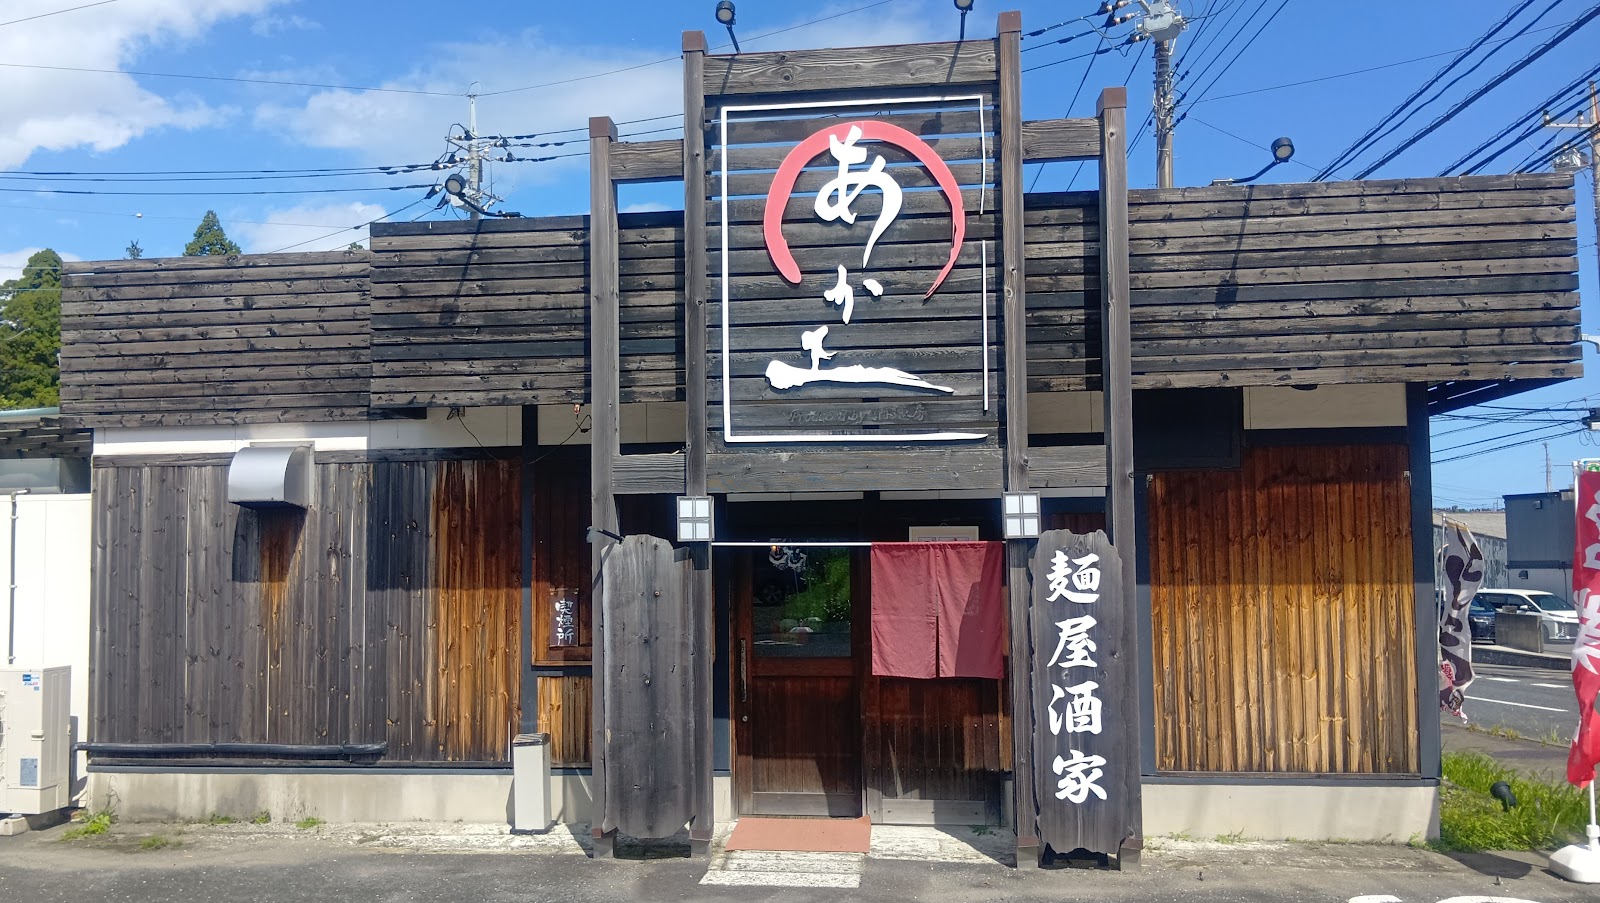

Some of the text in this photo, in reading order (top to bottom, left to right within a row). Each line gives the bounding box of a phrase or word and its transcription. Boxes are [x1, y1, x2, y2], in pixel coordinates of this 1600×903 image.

[555, 598, 575, 646] 喫煙所
[1046, 550, 1108, 804] 麺屋酒家
